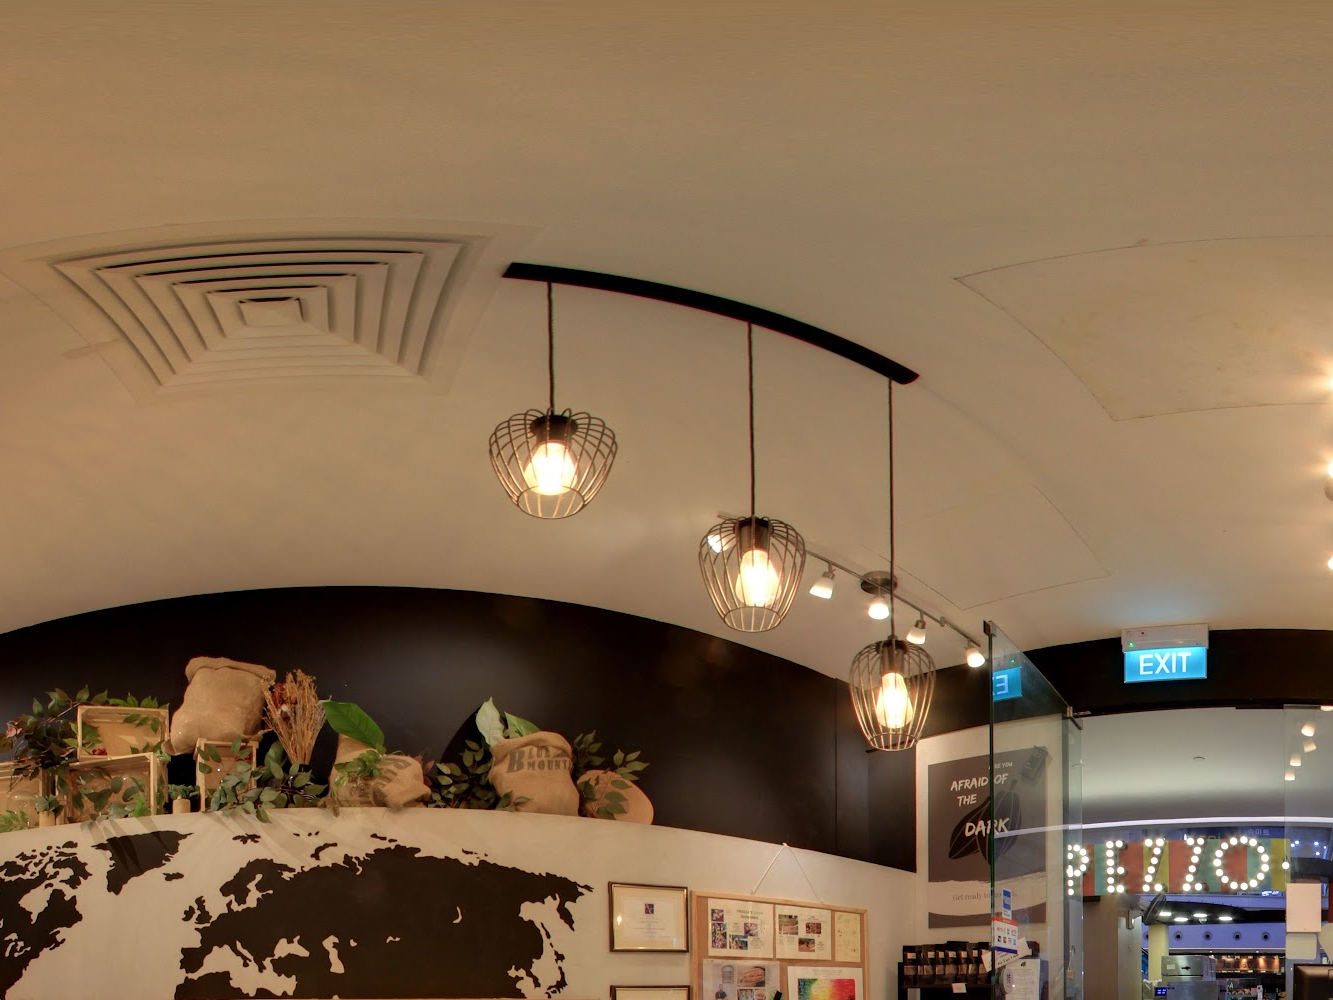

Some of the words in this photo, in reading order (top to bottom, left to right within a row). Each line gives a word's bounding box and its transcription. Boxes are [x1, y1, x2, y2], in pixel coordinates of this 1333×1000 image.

[1139, 652, 1192, 675] EXIT
[950, 776, 989, 792] AFRAID
[994, 773, 1009, 784] OF
[957, 794, 977, 807] THE
[965, 817, 1010, 837] DARK
[1066, 835, 1270, 896] PEZZO
[953, 893, 964, 902] Get
[964, 892, 982, 903] ready
